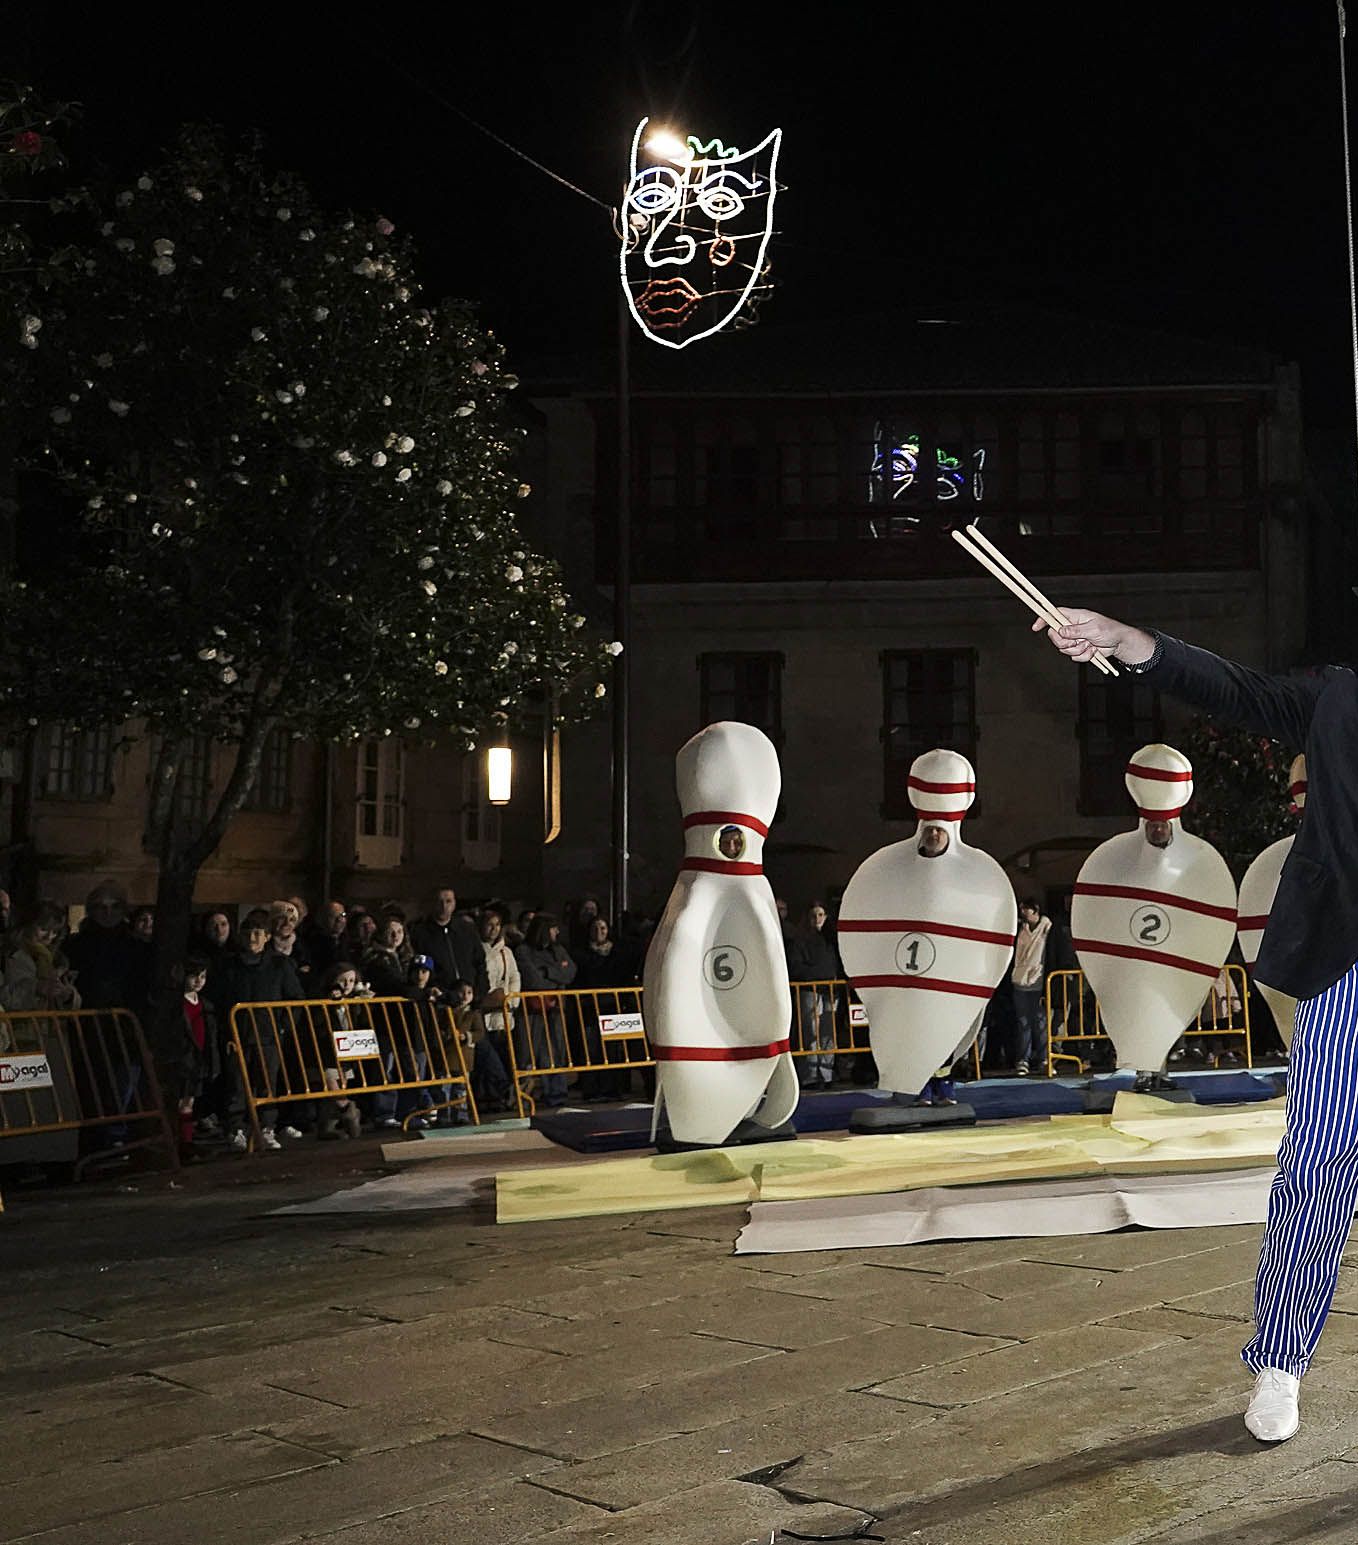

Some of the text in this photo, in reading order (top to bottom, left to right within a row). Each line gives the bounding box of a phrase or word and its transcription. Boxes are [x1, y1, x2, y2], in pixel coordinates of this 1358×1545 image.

[1140, 913, 1161, 941] 2
[713, 953, 734, 982] 6
[905, 940, 920, 971] 1
